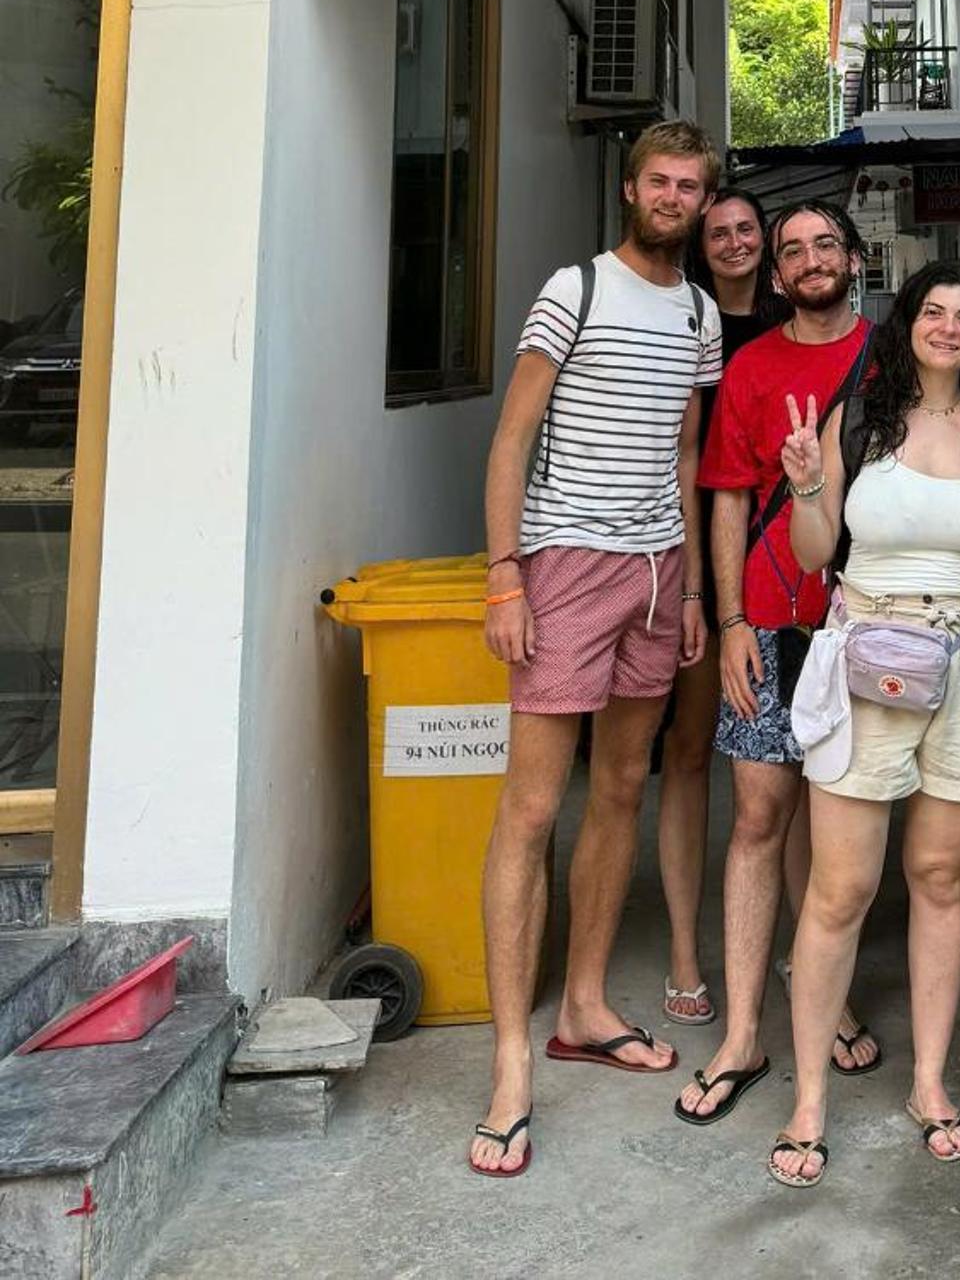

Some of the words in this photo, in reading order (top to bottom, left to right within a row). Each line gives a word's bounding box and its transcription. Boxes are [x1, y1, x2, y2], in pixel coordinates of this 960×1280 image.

[471, 716, 500, 729] RÁC
[406, 746, 422, 760] 94
[428, 741, 456, 759] NÚI
